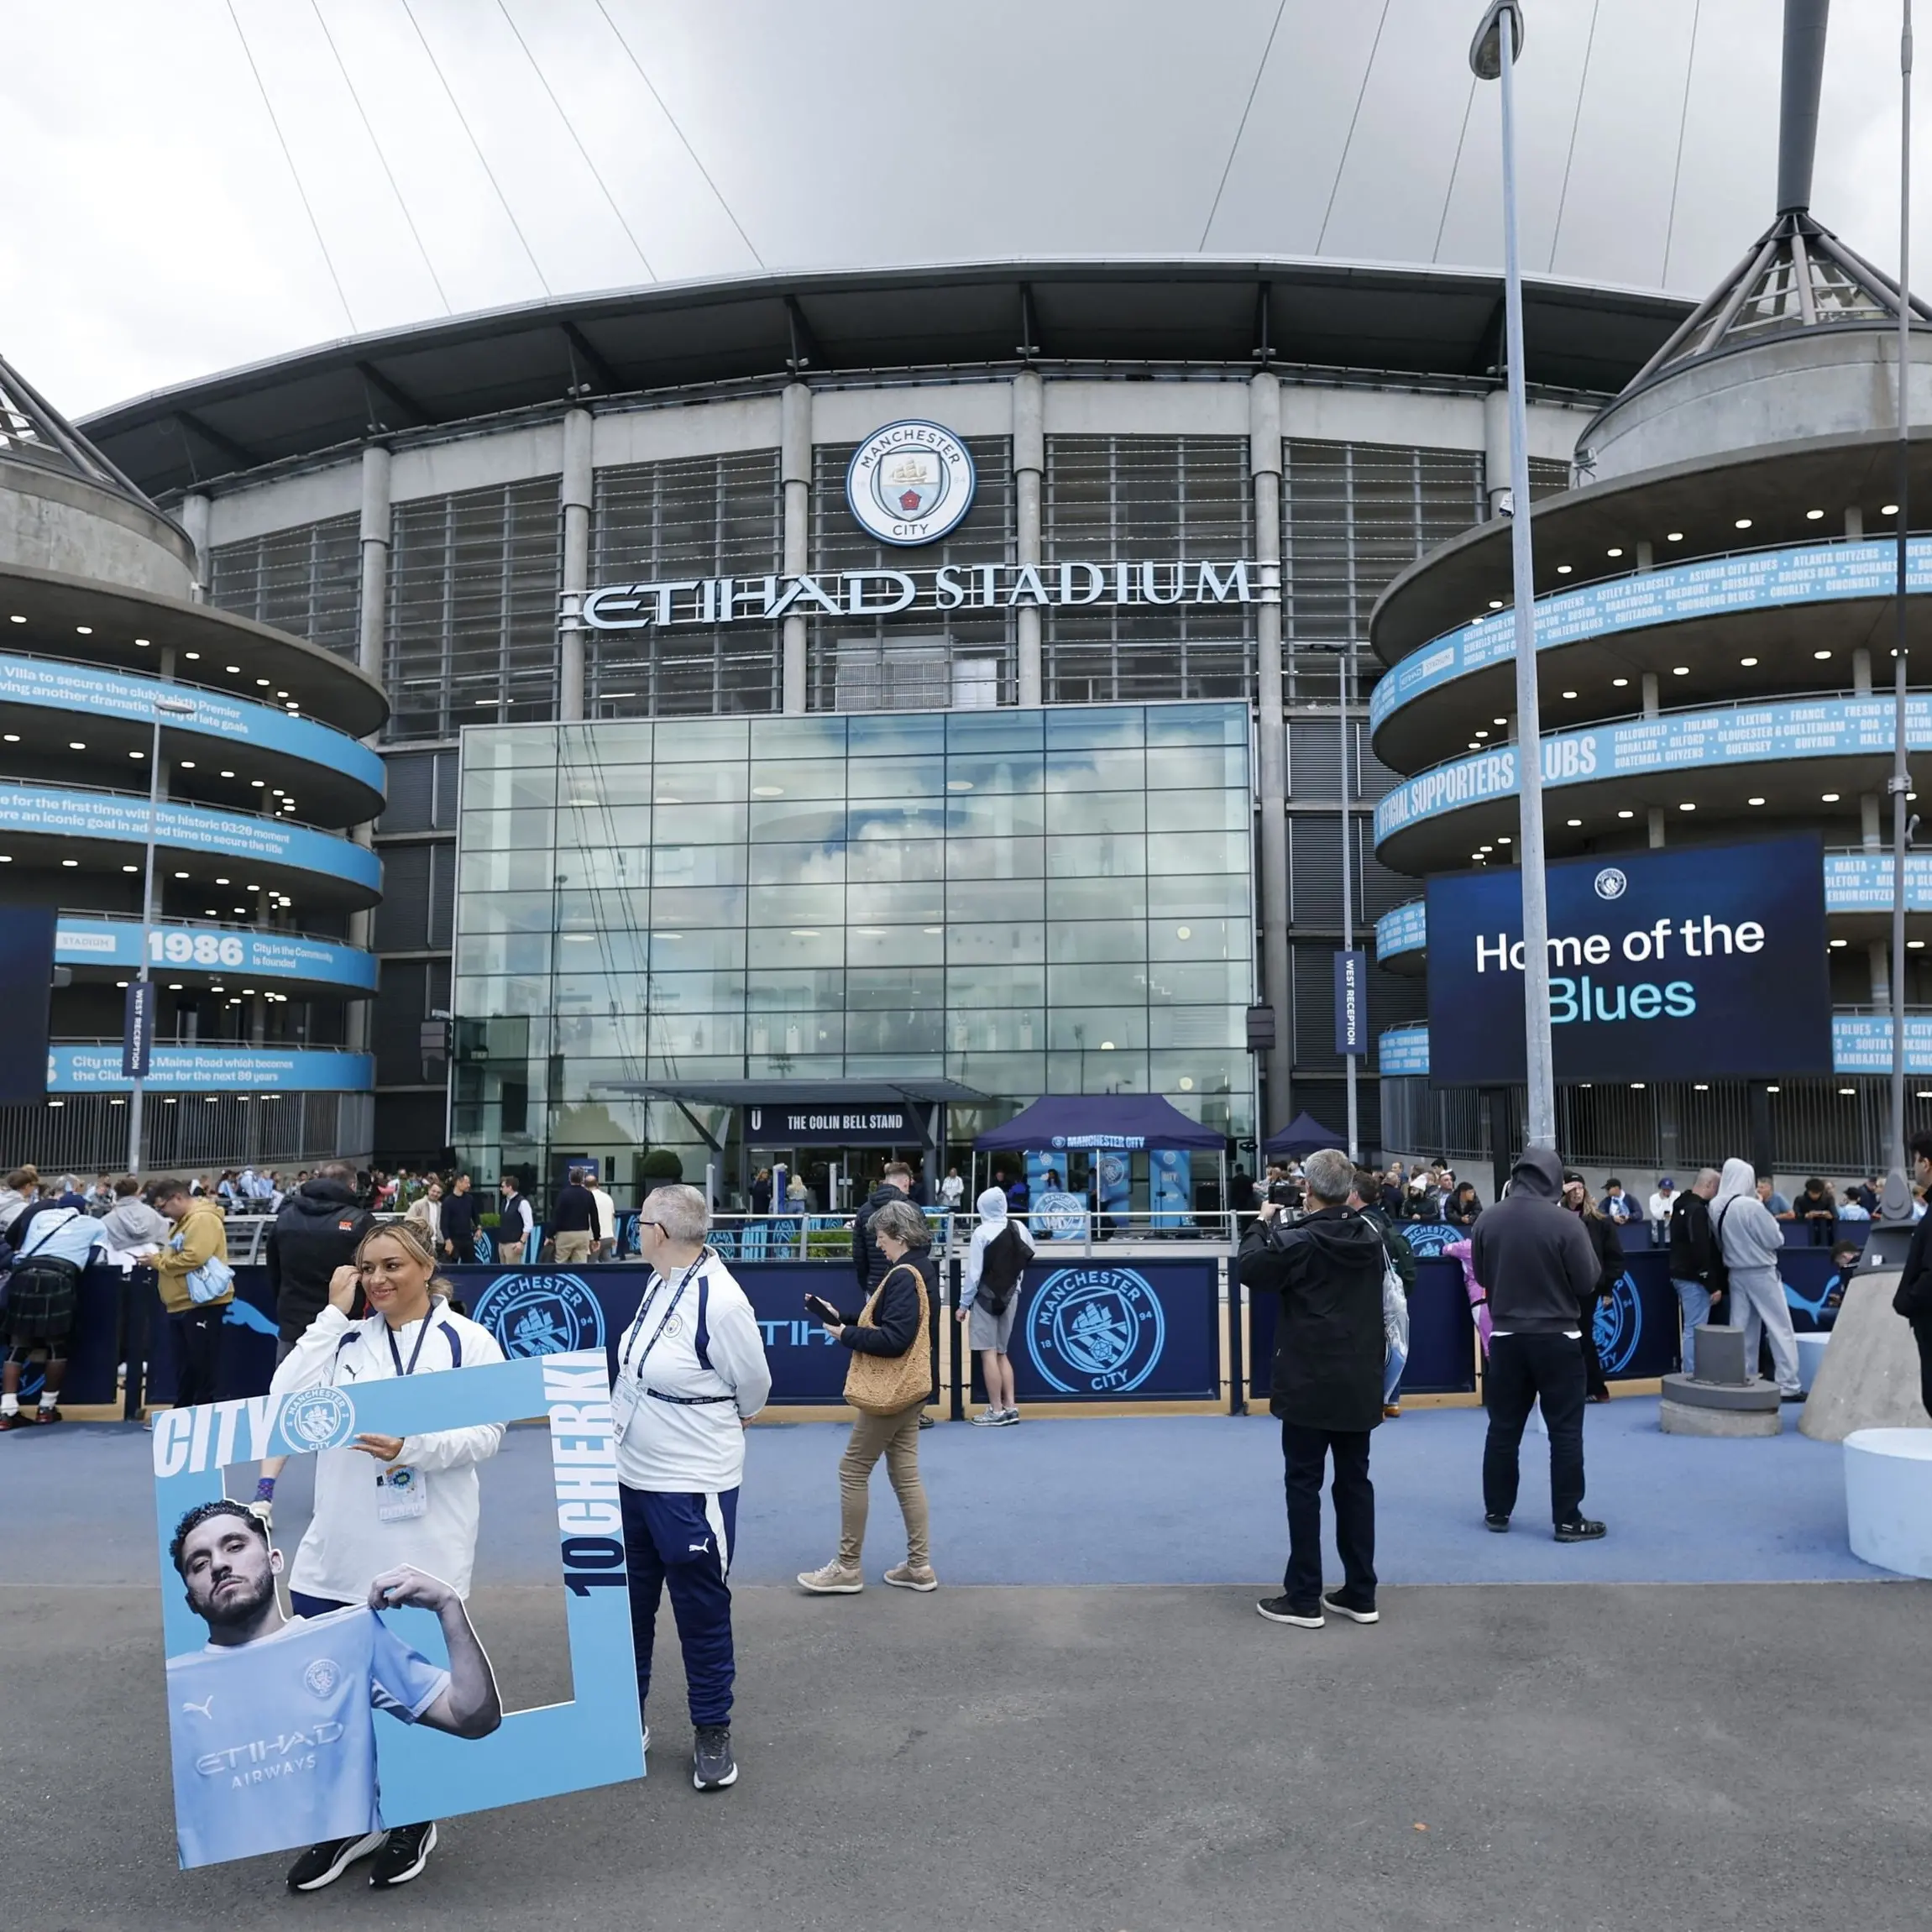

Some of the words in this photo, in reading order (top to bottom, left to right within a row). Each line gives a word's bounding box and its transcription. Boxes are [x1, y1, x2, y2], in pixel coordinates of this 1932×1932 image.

[861, 429, 961, 469] MANCHESTER
[893, 524, 929, 536] CITY
[1690, 566, 1725, 582] ASTORIA
[1728, 563, 1747, 576] CITY
[1750, 559, 1778, 572] BLUES
[1793, 552, 1834, 568] ATLANTA
[1850, 561, 1898, 575] BUCHARES
[583, 570, 916, 629] ETIHAD
[935, 560, 1251, 611] STADIUM
[3, 666, 36, 680] Villa
[39, 673, 53, 683] to
[57, 676, 102, 690] secure
[106, 683, 127, 695] the
[33, 686, 87, 701] another
[91, 694, 149, 711] dramatic
[1615, 725, 1668, 742] FALLOWFIELD
[1790, 708, 1825, 722] FRANCE
[1411, 752, 1515, 817] SUPPORTERS
[1540, 736, 1596, 782] UBS
[22, 813, 39, 822] an
[87, 817, 115, 830] goal
[35, 798, 59, 809] the
[62, 800, 91, 813] first
[93, 804, 123, 817] time
[156, 811, 175, 824] the
[1835, 860, 1867, 873] MALTA
[148, 931, 244, 966] 1986
[253, 942, 272, 956] City
[1623, 919, 1672, 961] of
[1680, 914, 1765, 956] the
[262, 958, 296, 968] founded
[1346, 960, 1354, 988] WEST
[134, 989, 144, 1016] WEST
[1548, 976, 1697, 1024] Blues
[1347, 990, 1356, 1045] RECEPTION
[72, 1056, 101, 1069] City
[157, 1058, 190, 1068] Maine
[195, 1058, 223, 1068] Road
[73, 1071, 96, 1081] the
[175, 1071, 191, 1081] for
[193, 1071, 211, 1081] the
[212, 1072, 236, 1081] next
[788, 1116, 807, 1130] THE
[809, 1115, 840, 1130] COLIN
[843, 1115, 867, 1129] BELL
[869, 1114, 903, 1129] STAND
[1067, 1135, 1124, 1149] MANCHESTER
[1126, 1136, 1144, 1149] CITY
[483, 1276, 583, 1331] MANCHESTER
[1039, 1271, 1141, 1326] MANCHESTER
[580, 1316, 594, 1327] 94
[1139, 1311, 1153, 1322] 94
[1040, 1339, 1052, 1349] 18
[1599, 1351, 1617, 1370] ITY
[1092, 1369, 1128, 1390] CITY
[288, 1389, 346, 1416] MANCHESTER
[153, 1393, 283, 1478] CITY
[309, 1440, 330, 1451] CITY
[542, 1350, 622, 1536] CHERKI
[563, 1537, 628, 1597] 10
[196, 1721, 344, 1776] ETIHAD
[232, 1755, 317, 1788] AIRWAYS
